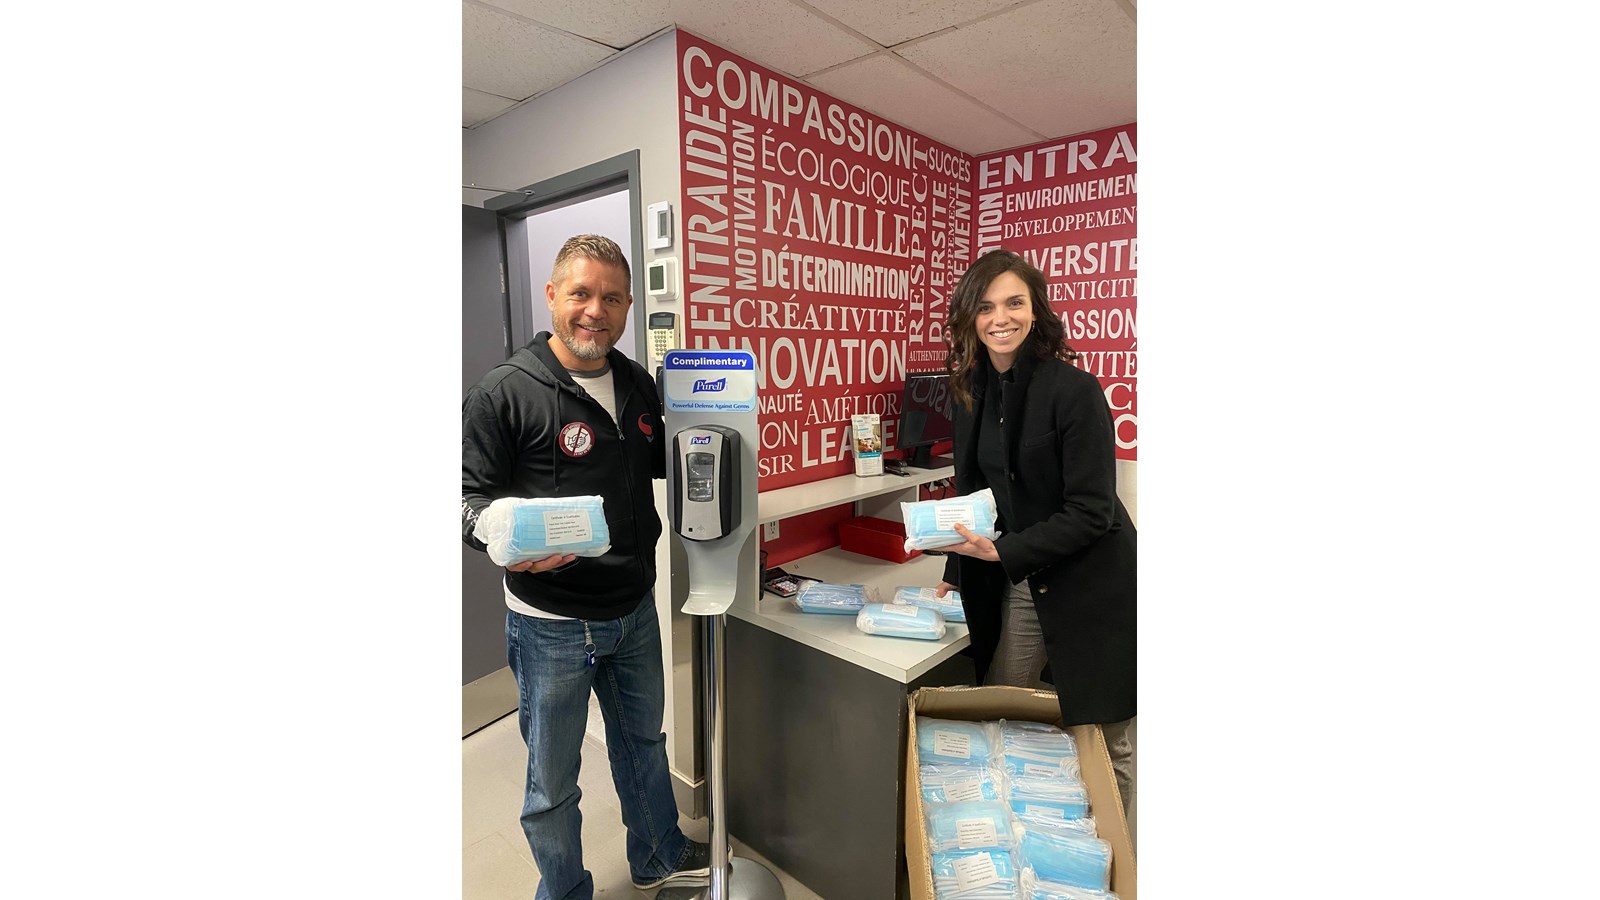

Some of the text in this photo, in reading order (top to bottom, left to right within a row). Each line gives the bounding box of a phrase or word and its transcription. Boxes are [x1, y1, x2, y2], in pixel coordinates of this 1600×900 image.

[683, 46, 911, 169] COMPASSION
[761, 128, 910, 208] ÉCOLOGIQUE
[928, 146, 971, 183] SUCCÈS
[684, 96, 731, 331] ENTRAIDE
[732, 119, 757, 291] MOTIVATION
[761, 179, 910, 259] FAMILLE
[909, 137, 928, 346] RESPECT
[761, 243, 909, 301] DÉTERMINATION
[928, 180, 947, 343] DIVERSITE
[733, 293, 907, 334] CRÉATIVITÉ
[1055, 308, 1137, 340] ASSION
[672, 357, 748, 368] Complimentary
[804, 388, 902, 427] AMÉLIOR
